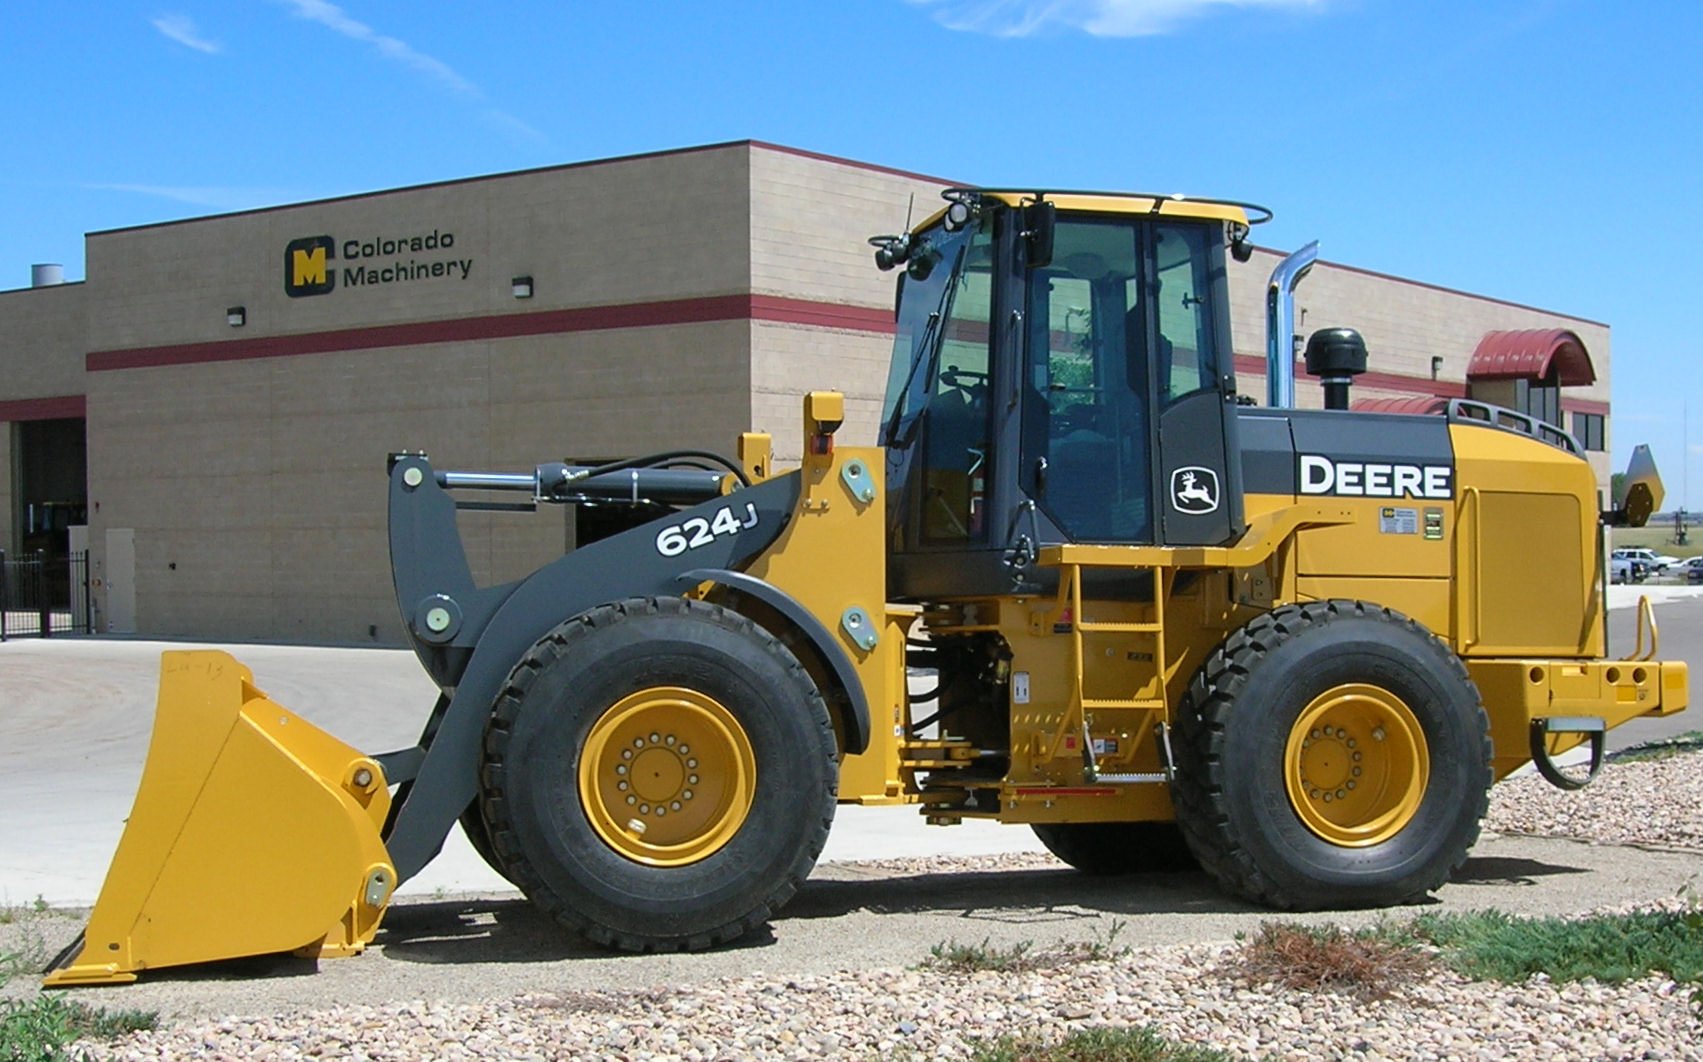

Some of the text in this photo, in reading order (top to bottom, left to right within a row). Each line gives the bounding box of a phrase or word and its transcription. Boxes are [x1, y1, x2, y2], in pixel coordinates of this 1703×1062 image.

[343, 229, 454, 260] Colorado
[343, 259, 473, 288] Machinery
[1300, 455, 1451, 498] DEERE
[656, 502, 759, 556] 624J
